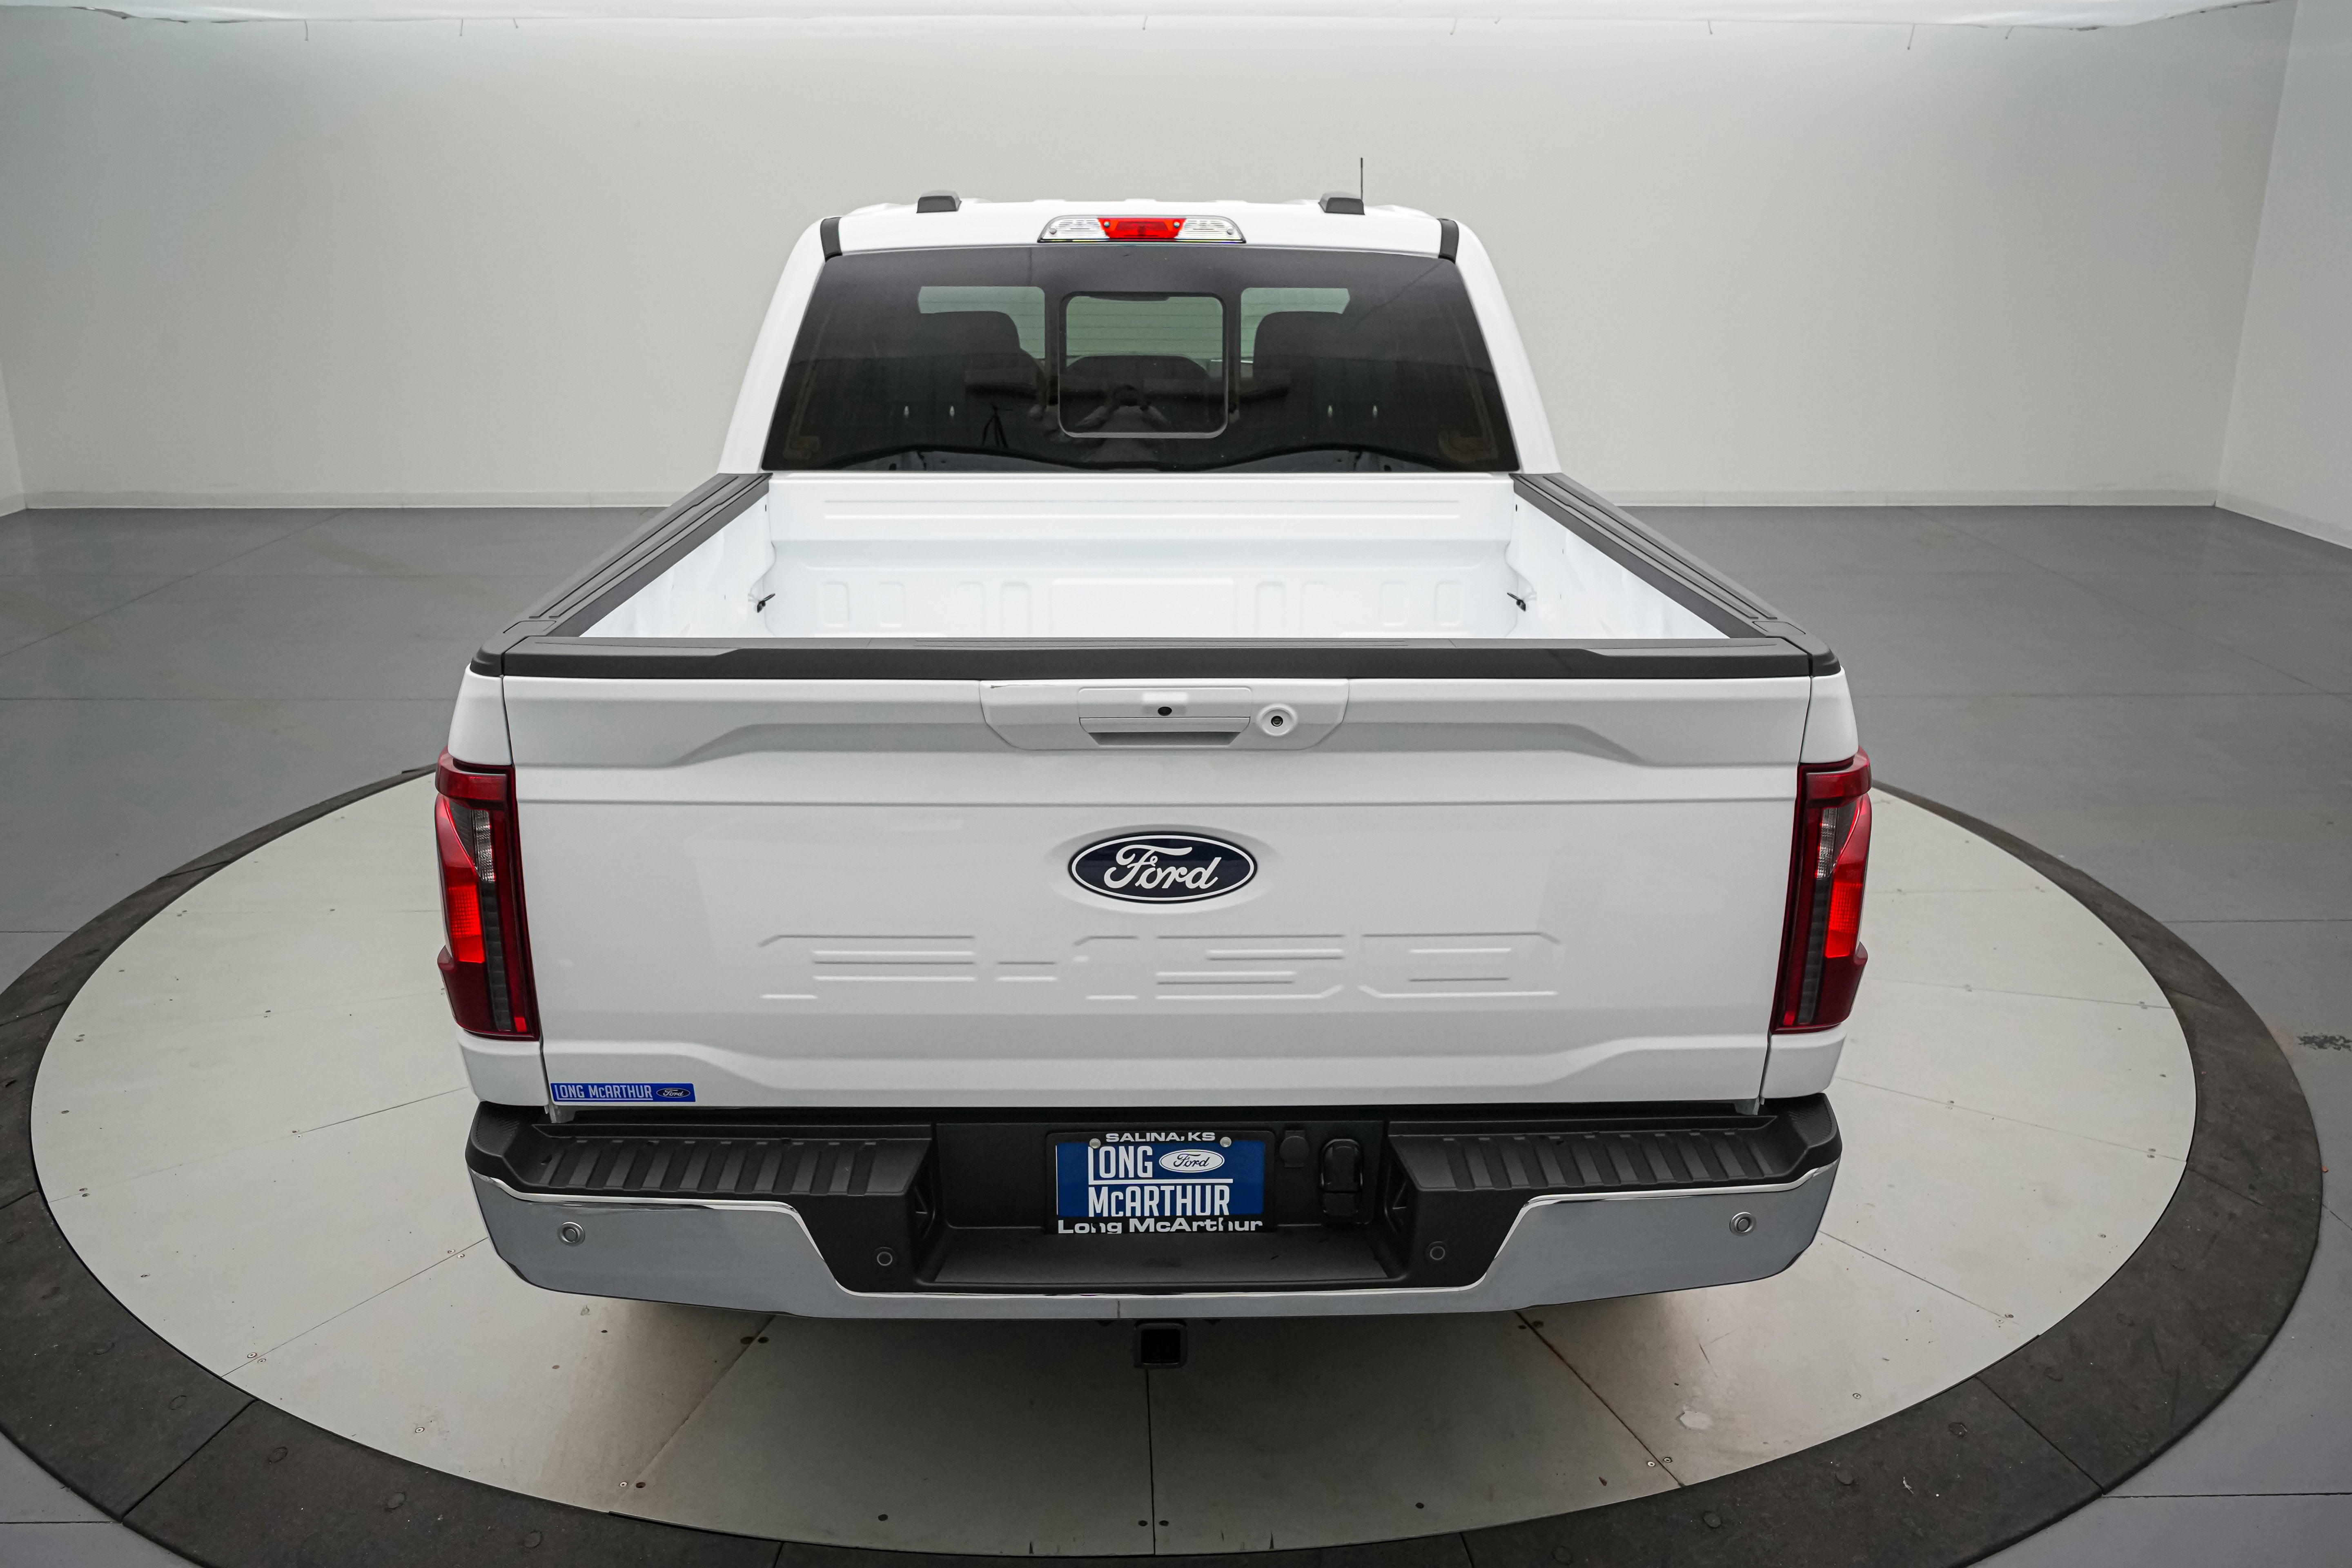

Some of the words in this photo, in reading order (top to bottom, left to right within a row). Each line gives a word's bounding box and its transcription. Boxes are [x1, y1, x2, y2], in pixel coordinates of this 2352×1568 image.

[1104, 844, 1222, 889] Ford
[555, 1085, 585, 1100] LONG
[588, 1085, 653, 1098] McARTHUR
[663, 1087, 684, 1096] Ford
[1106, 1132, 1185, 1142] SALINA,
[1188, 1132, 1216, 1141] KS
[1088, 1145, 1153, 1184] LONG
[1173, 1154, 1210, 1167] Ford
[1088, 1185, 1230, 1217] McARTHUR
[1058, 1220, 1122, 1234] Long
[1129, 1218, 1263, 1232] McArthur
